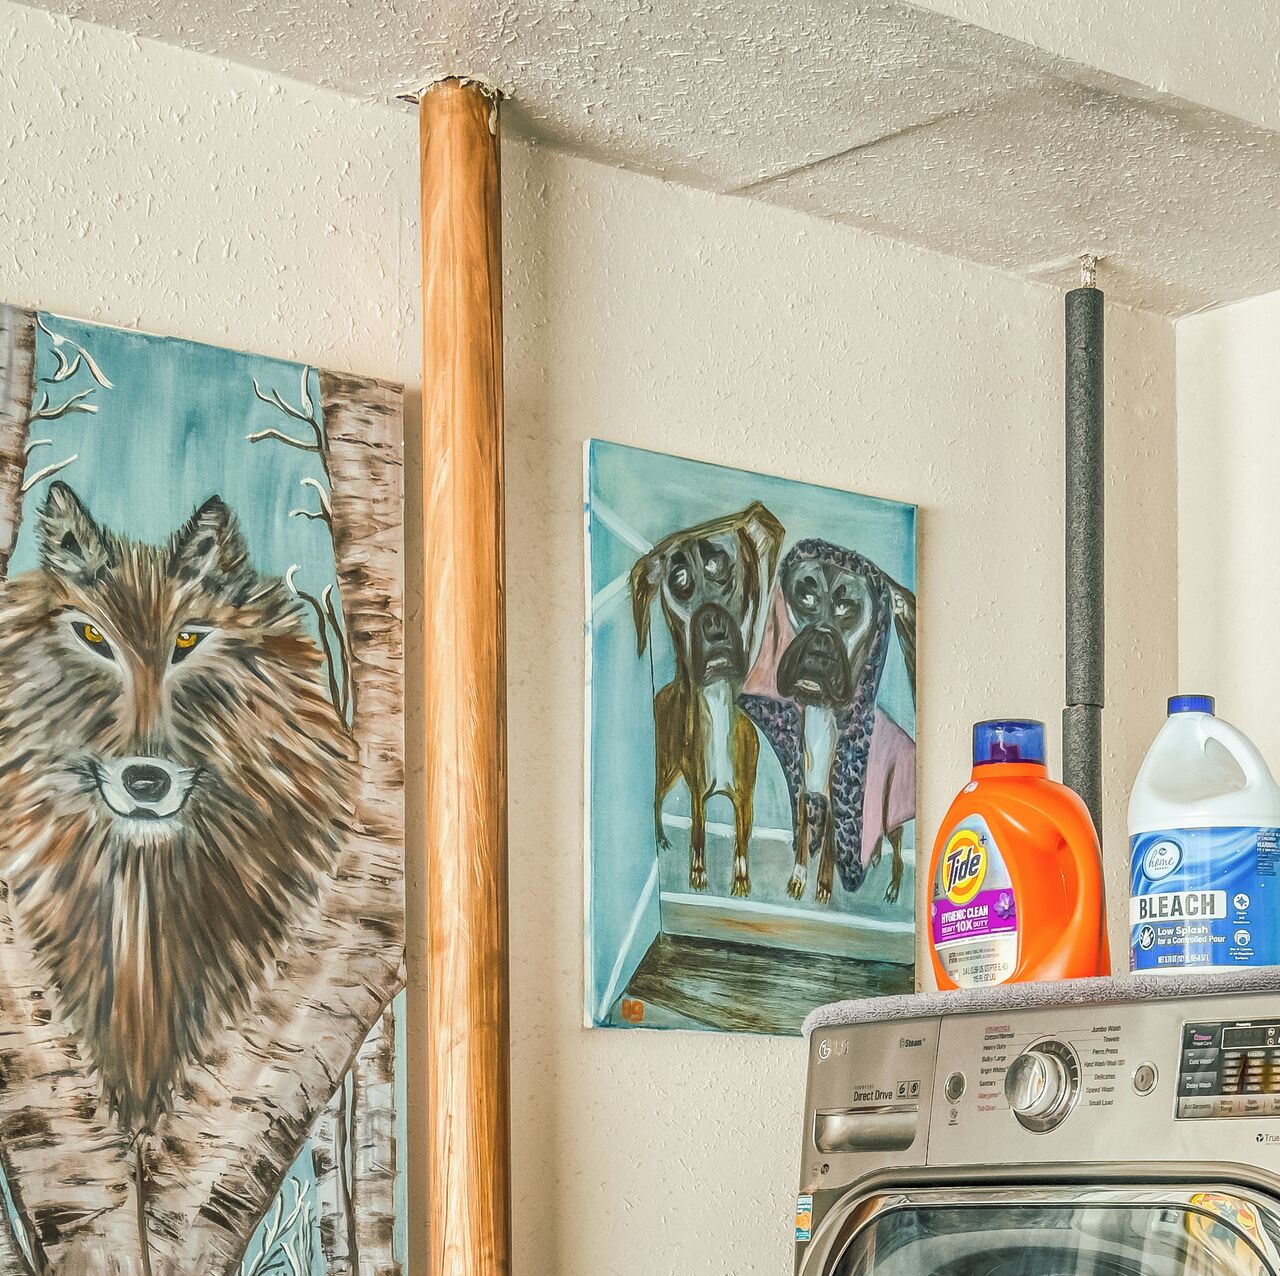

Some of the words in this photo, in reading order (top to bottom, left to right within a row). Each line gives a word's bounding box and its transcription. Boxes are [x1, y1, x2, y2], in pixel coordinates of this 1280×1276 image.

[1148, 850, 1174, 868] home
[946, 845, 981, 893] Tide
[1140, 894, 1215, 919] BLEACH
[942, 909, 966, 924] HYGIENIC
[967, 905, 988, 919] CLEAN
[956, 920, 972, 932] 10X
[1158, 927, 1173, 936] Low
[1176, 926, 1208, 935] Splash
[1158, 937, 1166, 945] for
[1172, 935, 1206, 944] Controlled
[854, 1091, 873, 1101] Direct
[875, 1090, 892, 1100] Drive
